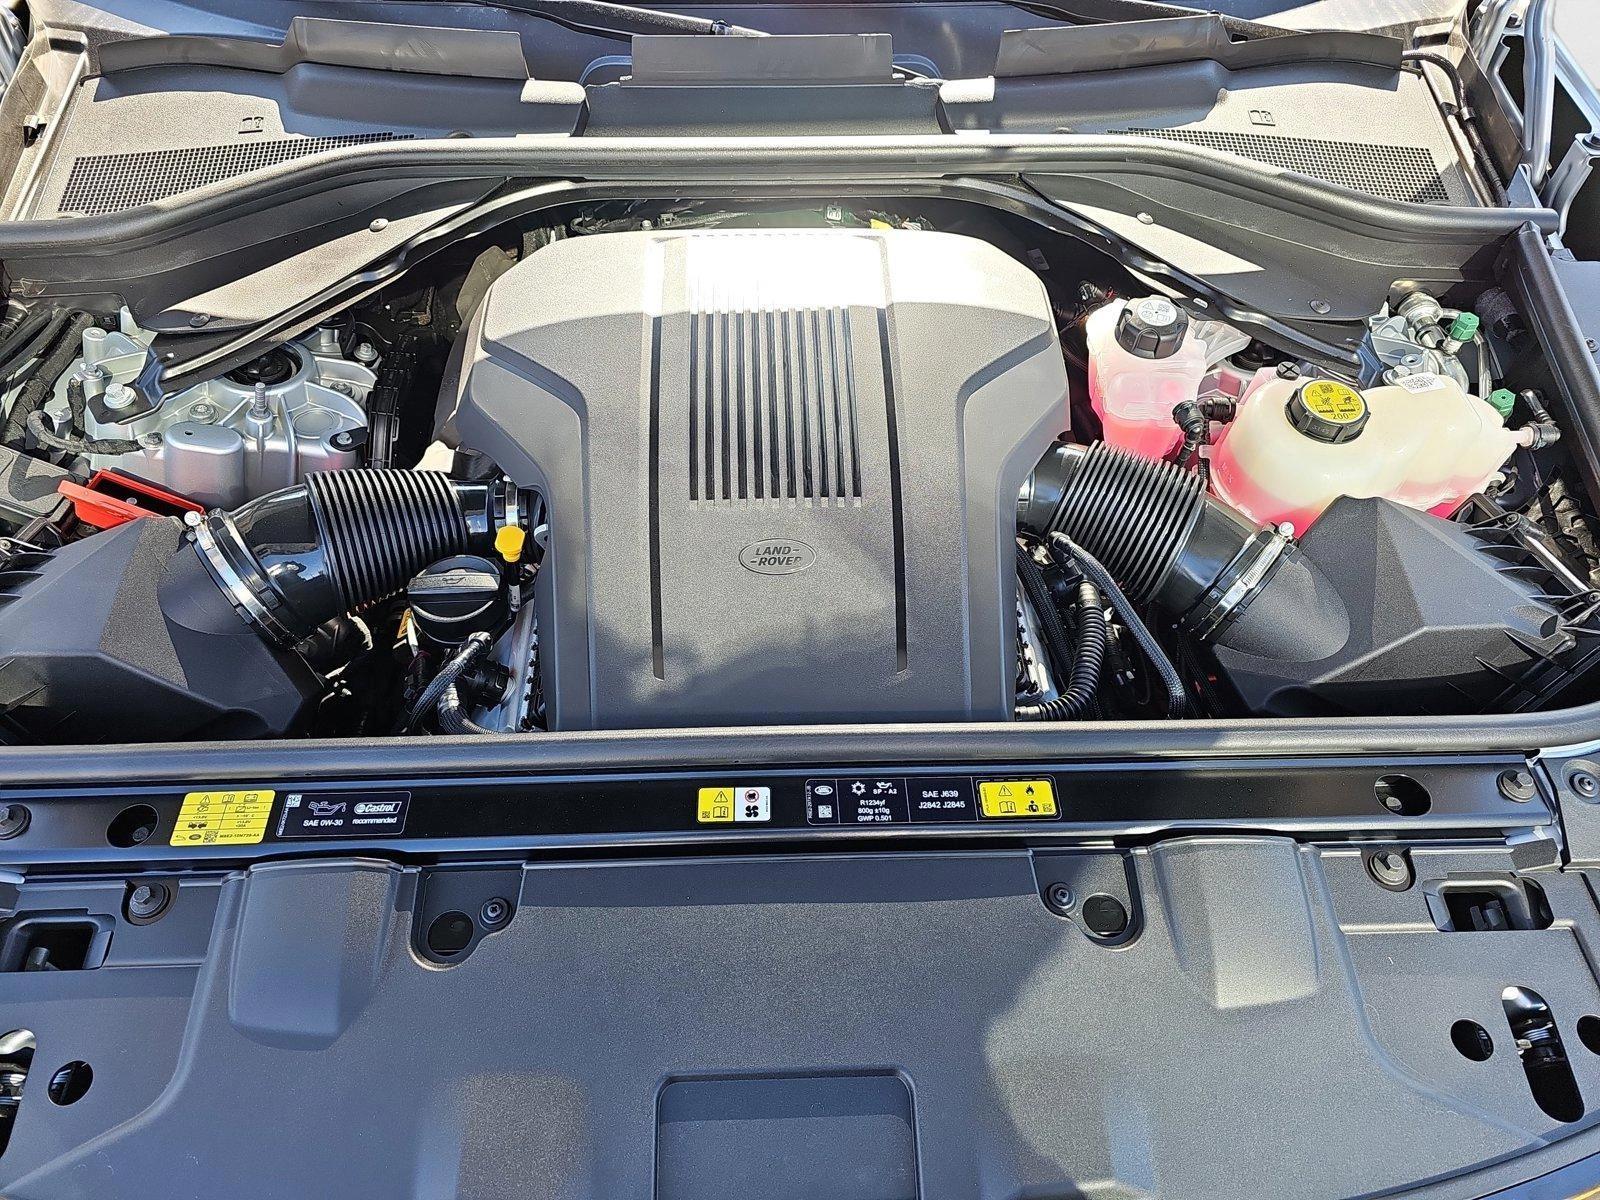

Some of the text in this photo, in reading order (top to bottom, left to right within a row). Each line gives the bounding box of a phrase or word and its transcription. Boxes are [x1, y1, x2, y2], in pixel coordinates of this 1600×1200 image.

[940, 790, 958, 798] J639
[365, 803, 395, 812] Castrol
[352, 817, 398, 825] recommended
